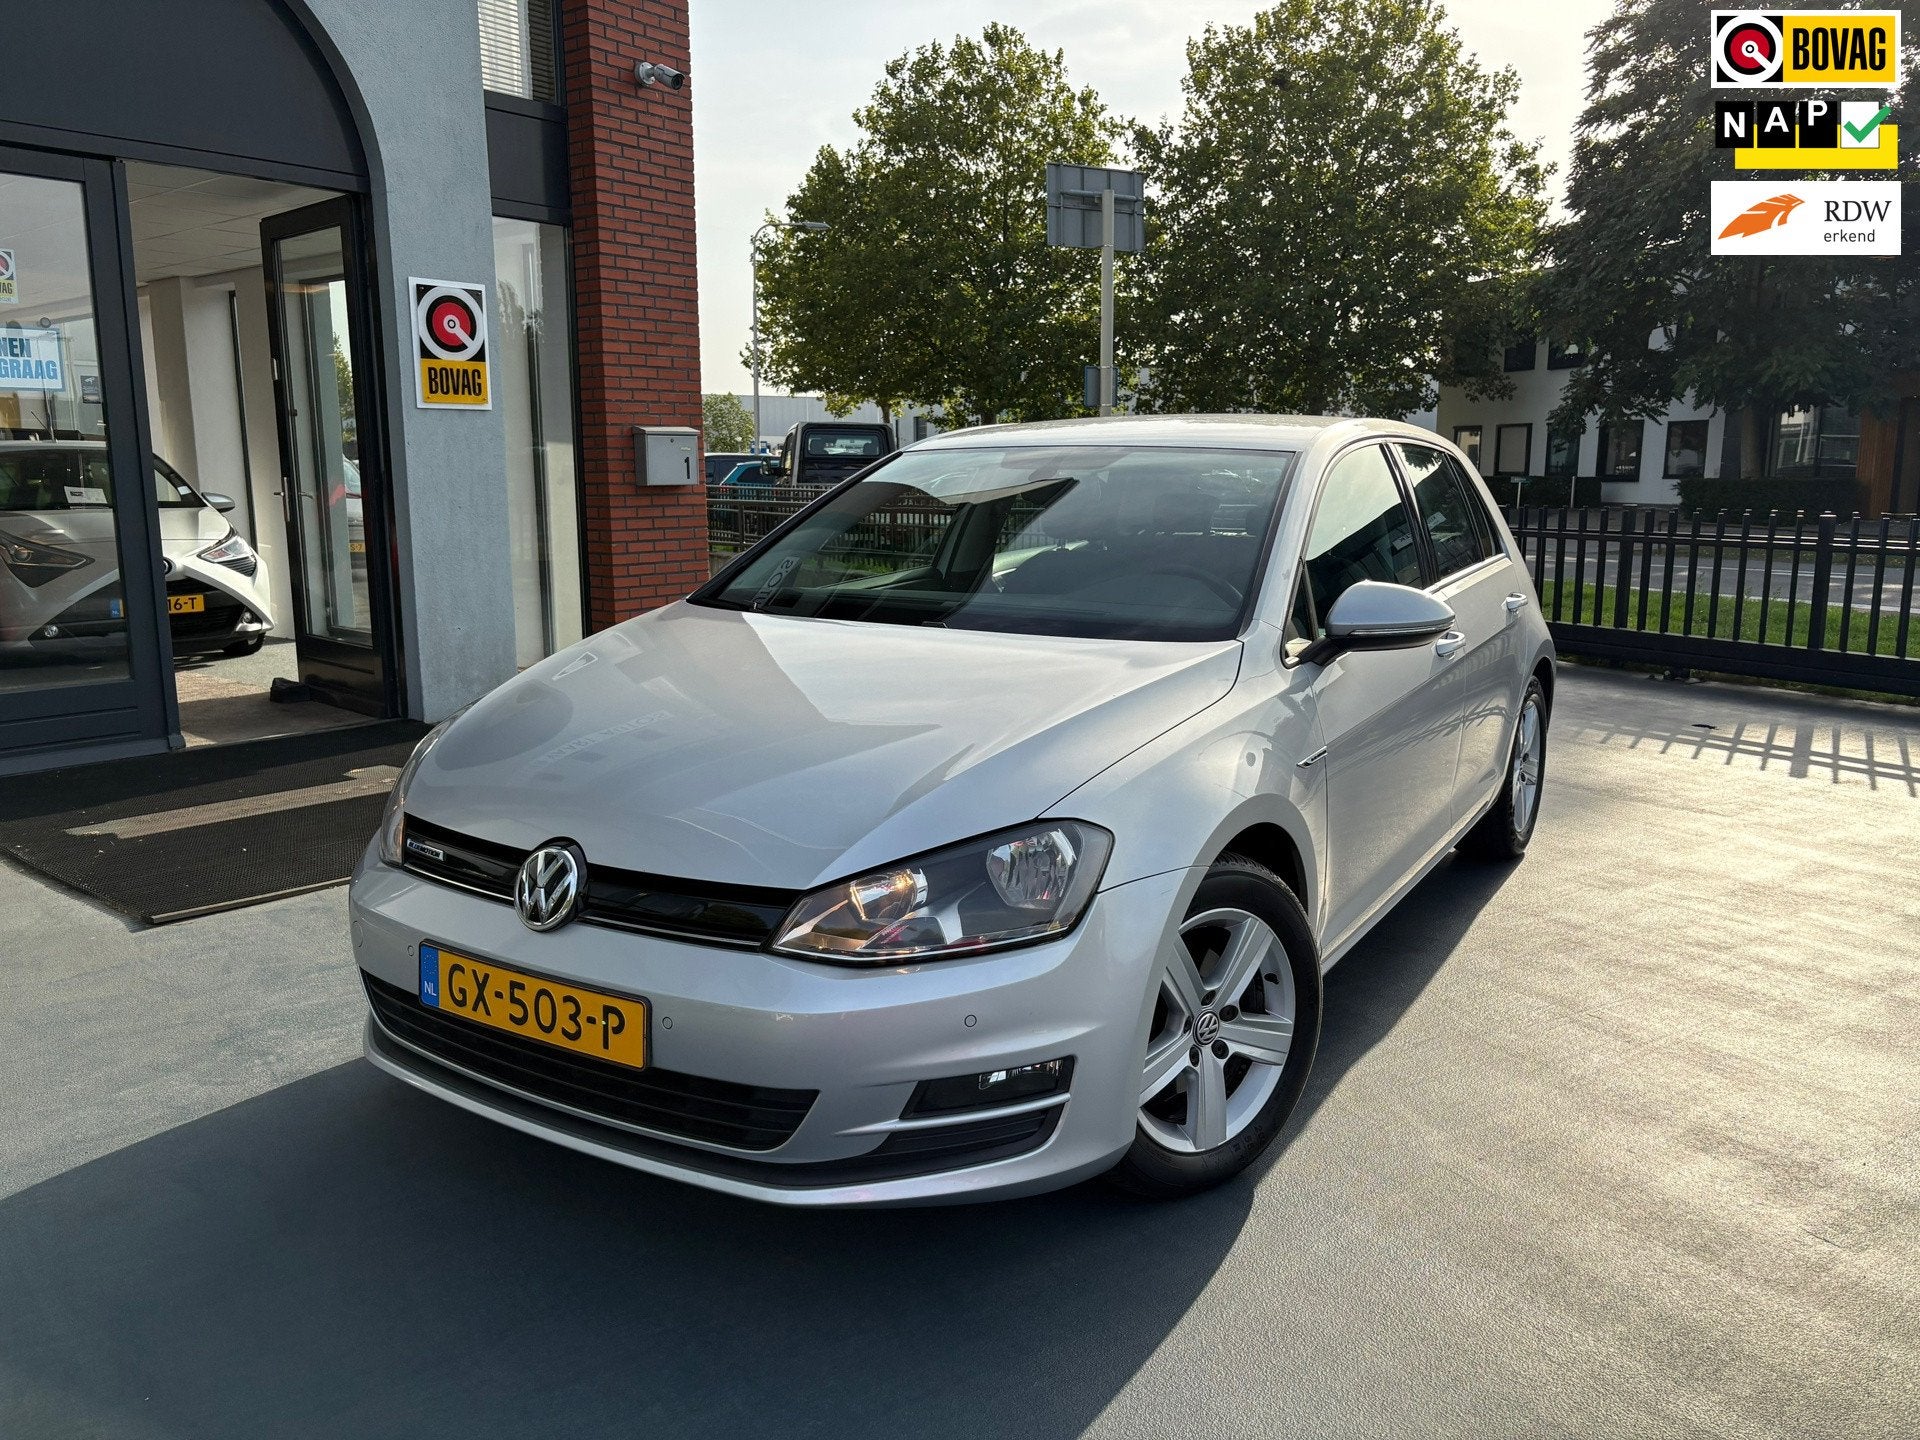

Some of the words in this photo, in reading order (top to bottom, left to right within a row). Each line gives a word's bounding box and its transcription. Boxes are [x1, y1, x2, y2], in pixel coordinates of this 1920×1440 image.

[428, 367, 482, 397] BOVAG
[684, 456, 690, 479] 1
[424, 980, 437, 997] NL
[448, 963, 626, 1050] GX-503-P
